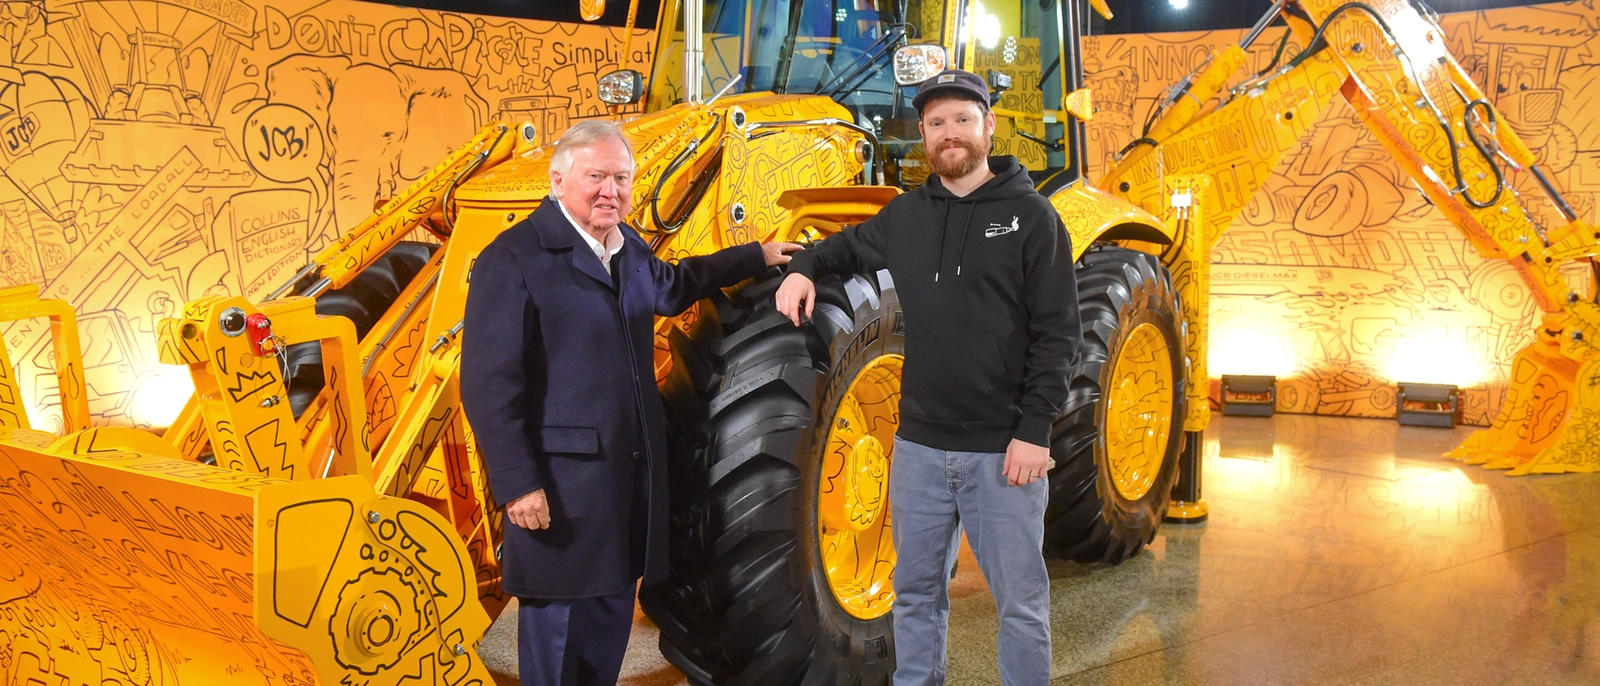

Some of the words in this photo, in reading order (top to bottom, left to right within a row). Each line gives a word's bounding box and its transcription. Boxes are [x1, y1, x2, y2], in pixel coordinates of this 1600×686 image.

[6, 117, 36, 152] JCB
[131, 159, 194, 220] LOADALL
[241, 206, 301, 235] COLLINS
[241, 226, 296, 254] ENGLISH
[244, 237, 303, 263] DICTIONARY
[247, 278, 266, 298] NEW
[267, 249, 303, 281] EDITION
